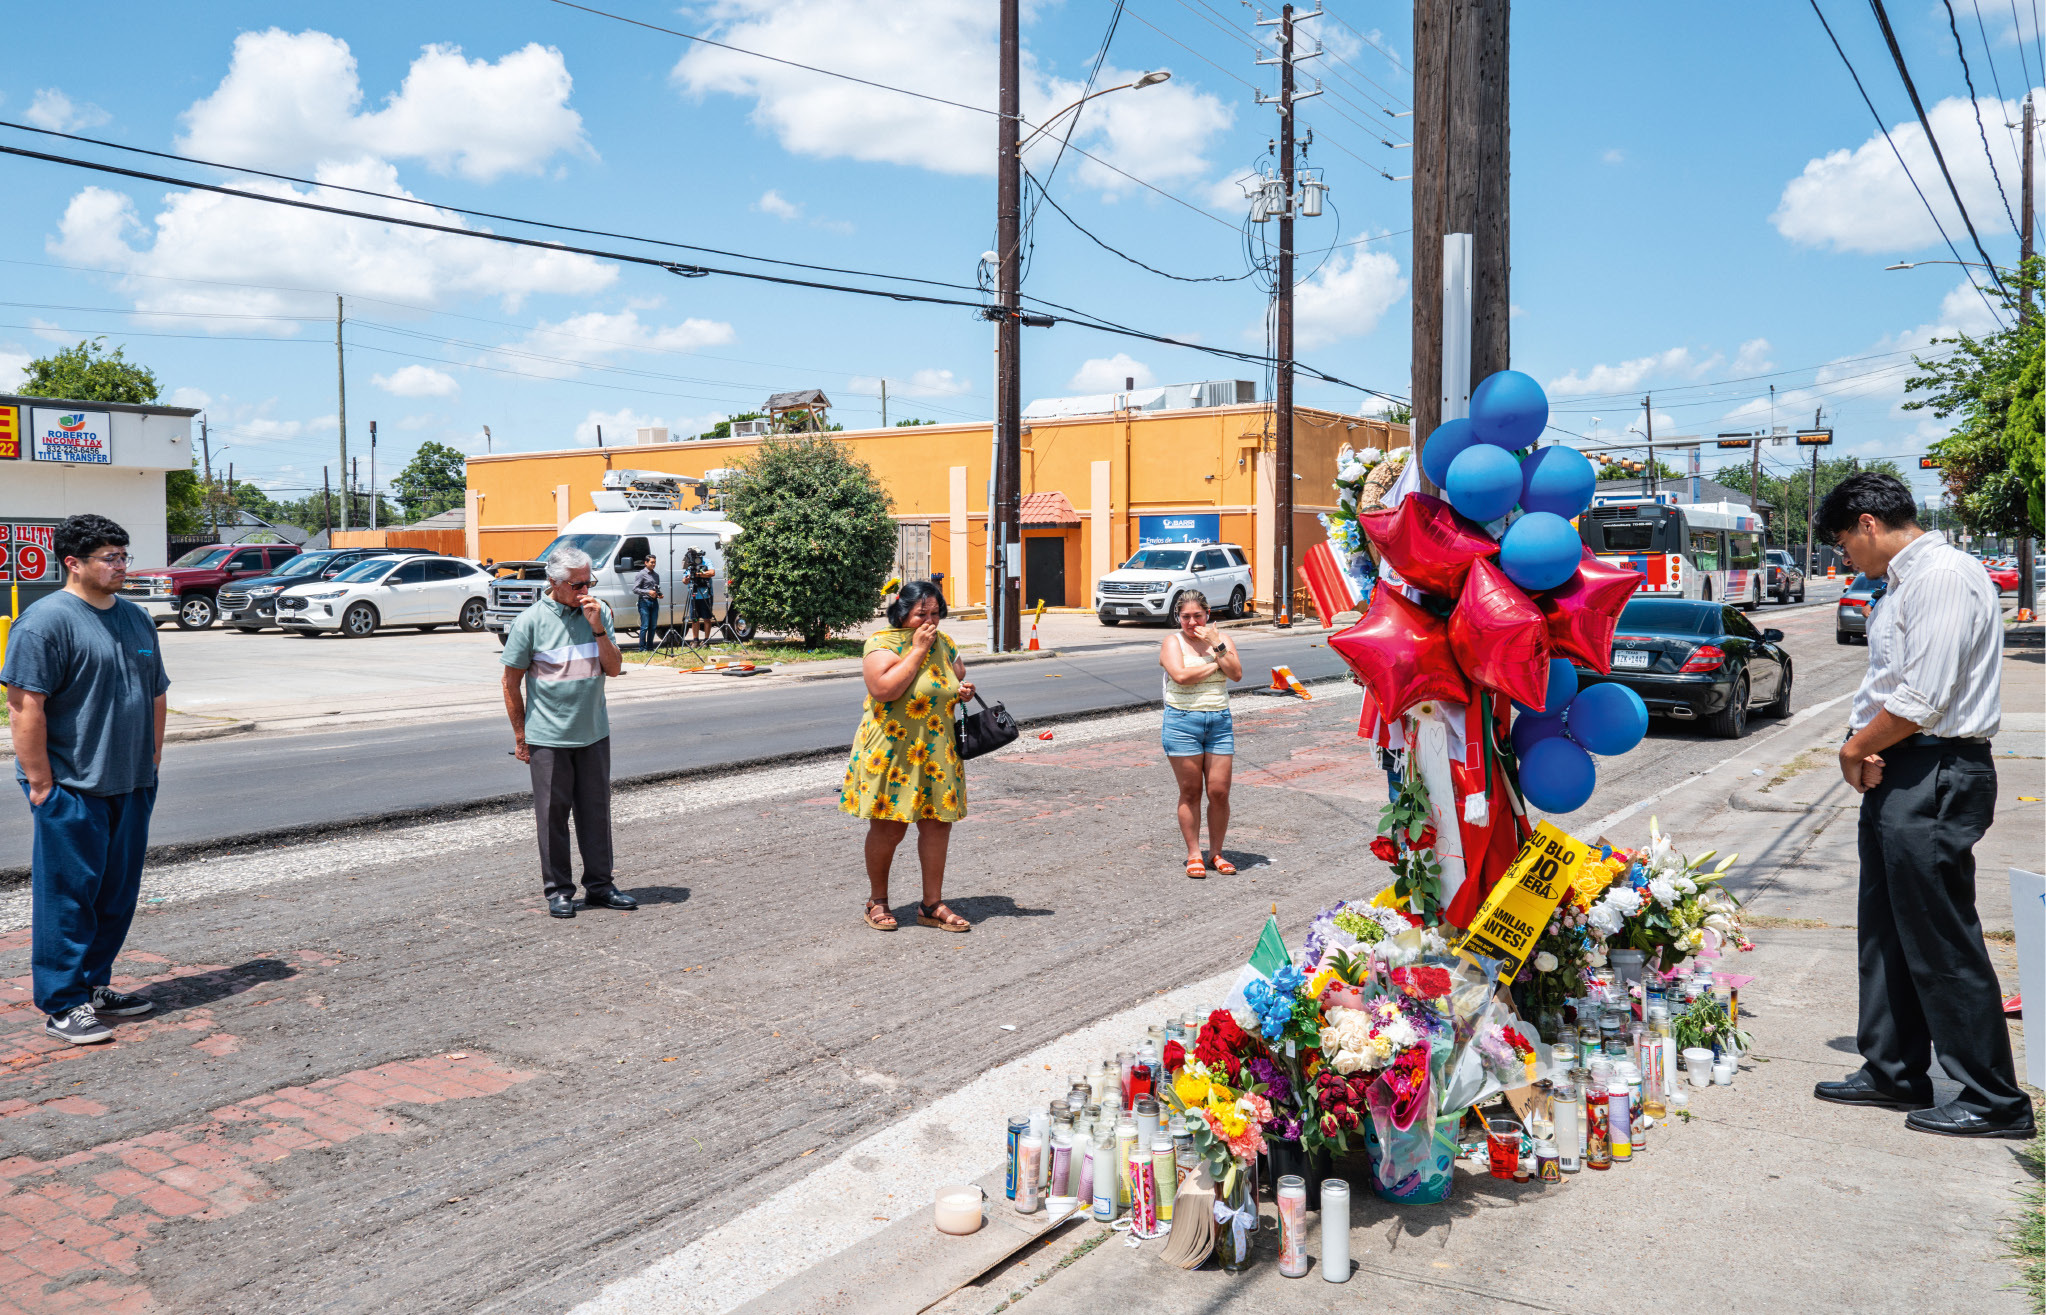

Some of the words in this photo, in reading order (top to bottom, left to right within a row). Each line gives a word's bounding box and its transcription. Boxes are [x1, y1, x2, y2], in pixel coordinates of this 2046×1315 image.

[48, 430, 97, 440] ROBERTO
[42, 436, 80, 446] INCOME
[83, 439, 102, 447] TAX
[46, 445, 100, 455] 832-229-6456
[38, 451, 62, 461] TITLE
[64, 452, 108, 463] TRANSFER
[1620, 561, 1638, 570] STOP
[1544, 840, 1576, 866] BLO
[1492, 907, 1535, 937] AMILIAS
